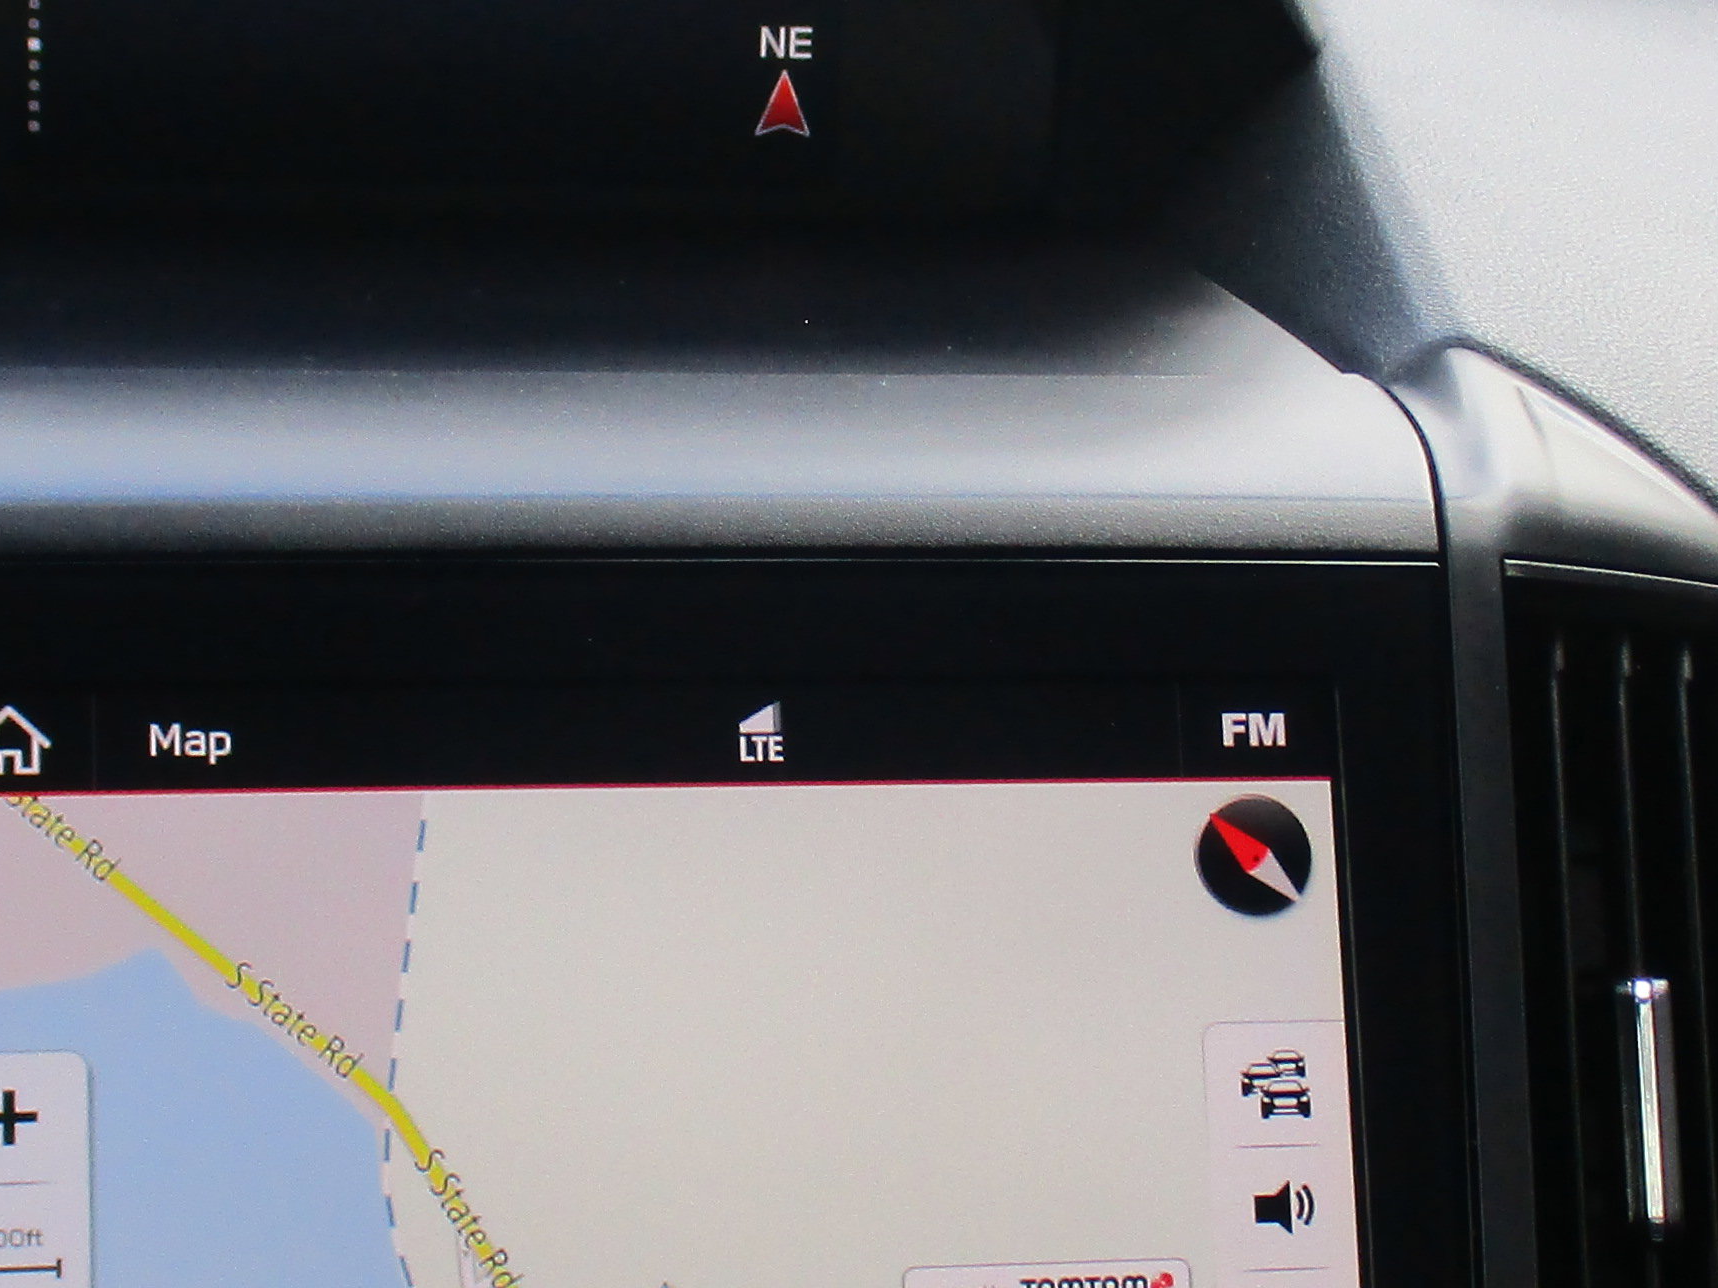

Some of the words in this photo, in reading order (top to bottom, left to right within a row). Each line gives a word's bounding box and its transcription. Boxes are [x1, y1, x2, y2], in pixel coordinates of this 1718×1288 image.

[759, 25, 814, 59] NE
[148, 722, 233, 766] Map
[739, 734, 785, 763] LTE
[1221, 711, 1287, 748] FM
[74, 838, 122, 881] Rd
[225, 961, 252, 989] S
[247, 979, 317, 1047] State
[318, 1033, 365, 1079] Rd
[414, 1148, 446, 1173] S
[430, 1173, 487, 1249] State
